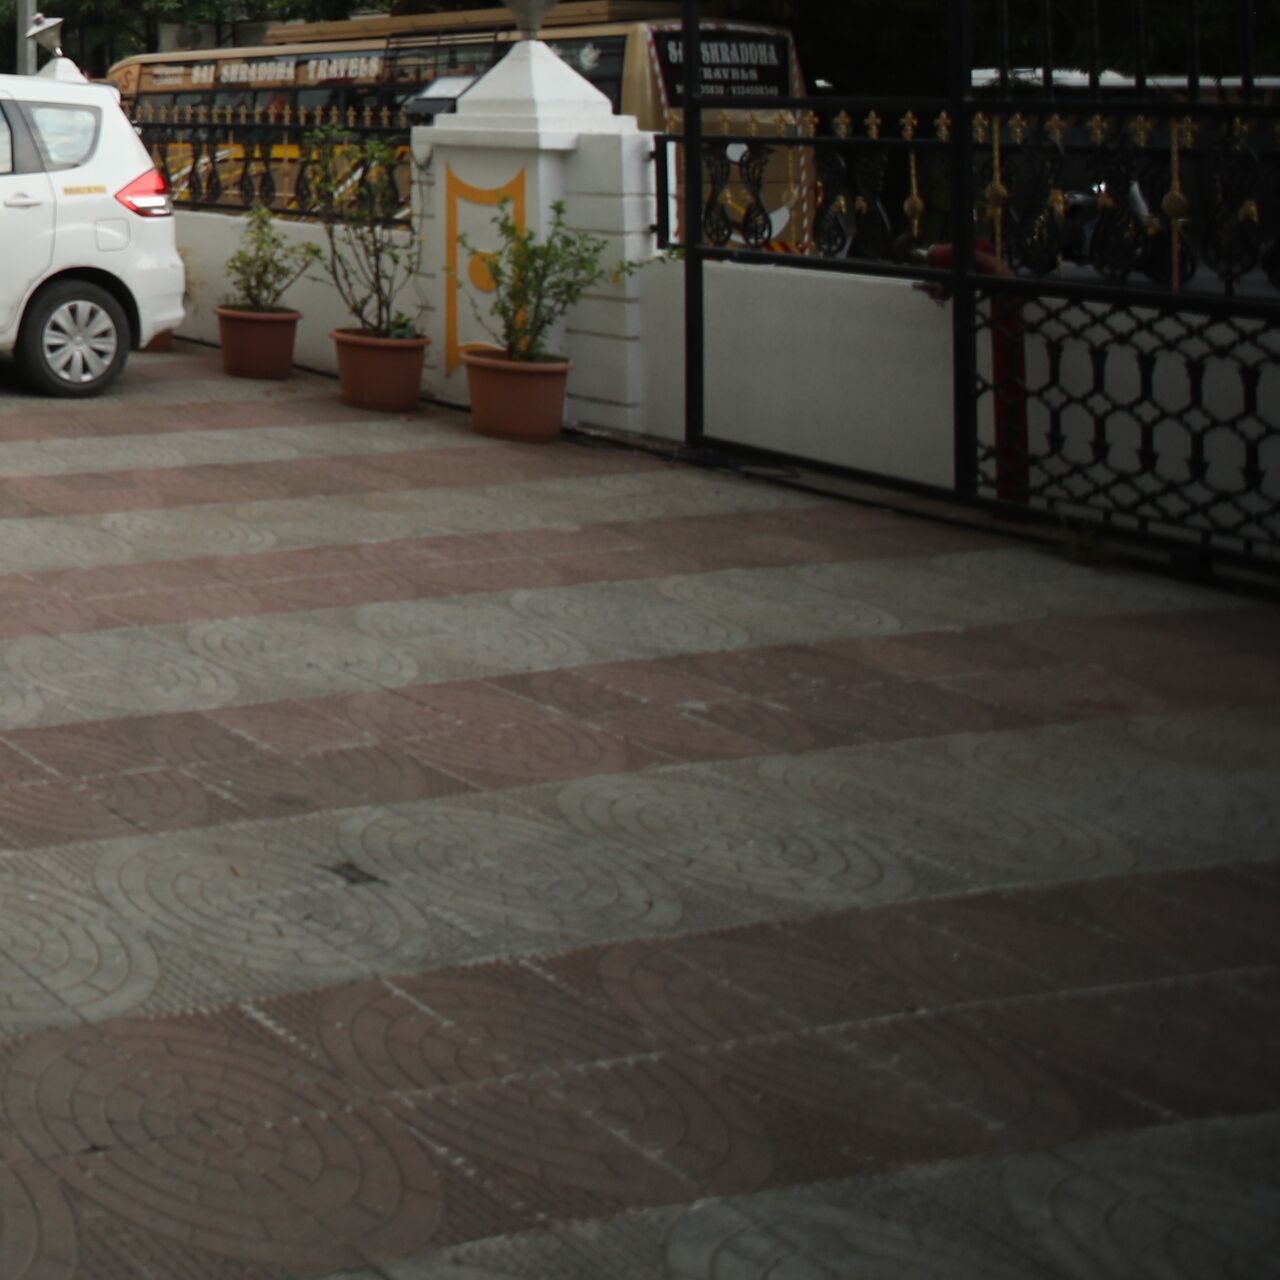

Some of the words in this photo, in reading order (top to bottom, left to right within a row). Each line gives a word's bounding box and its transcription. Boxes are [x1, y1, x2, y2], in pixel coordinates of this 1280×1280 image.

[700, 41, 778, 65] SHRADDHA
[306, 56, 380, 81] TRAVELS
[701, 68, 758, 81] RAVELS
